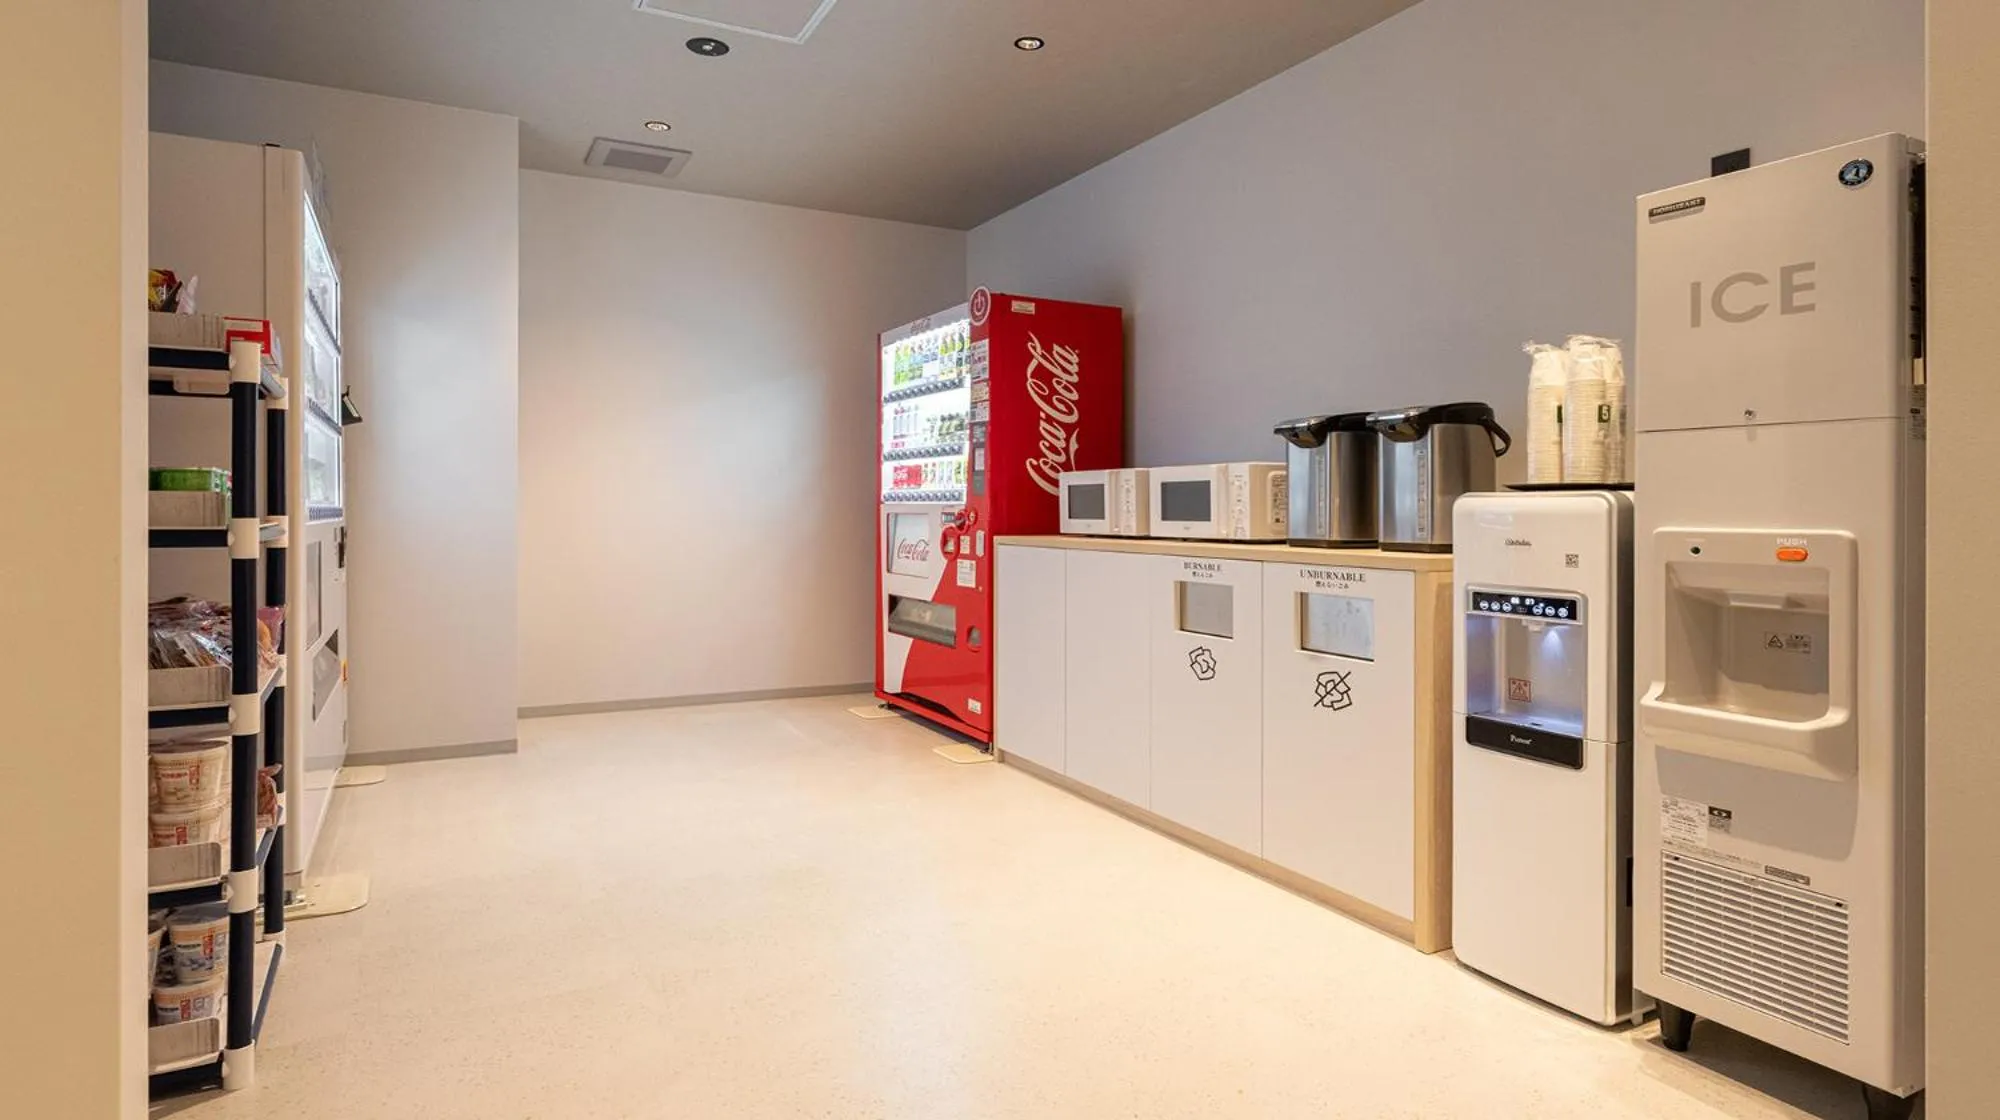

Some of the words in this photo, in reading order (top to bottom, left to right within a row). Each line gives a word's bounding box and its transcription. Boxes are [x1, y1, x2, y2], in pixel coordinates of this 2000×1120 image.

[1690, 261, 1816, 328] ICE
[1776, 537, 1808, 546] PUSH
[1183, 562, 1222, 573] BURNABLE
[1299, 569, 1367, 583] UNBURNABLE
